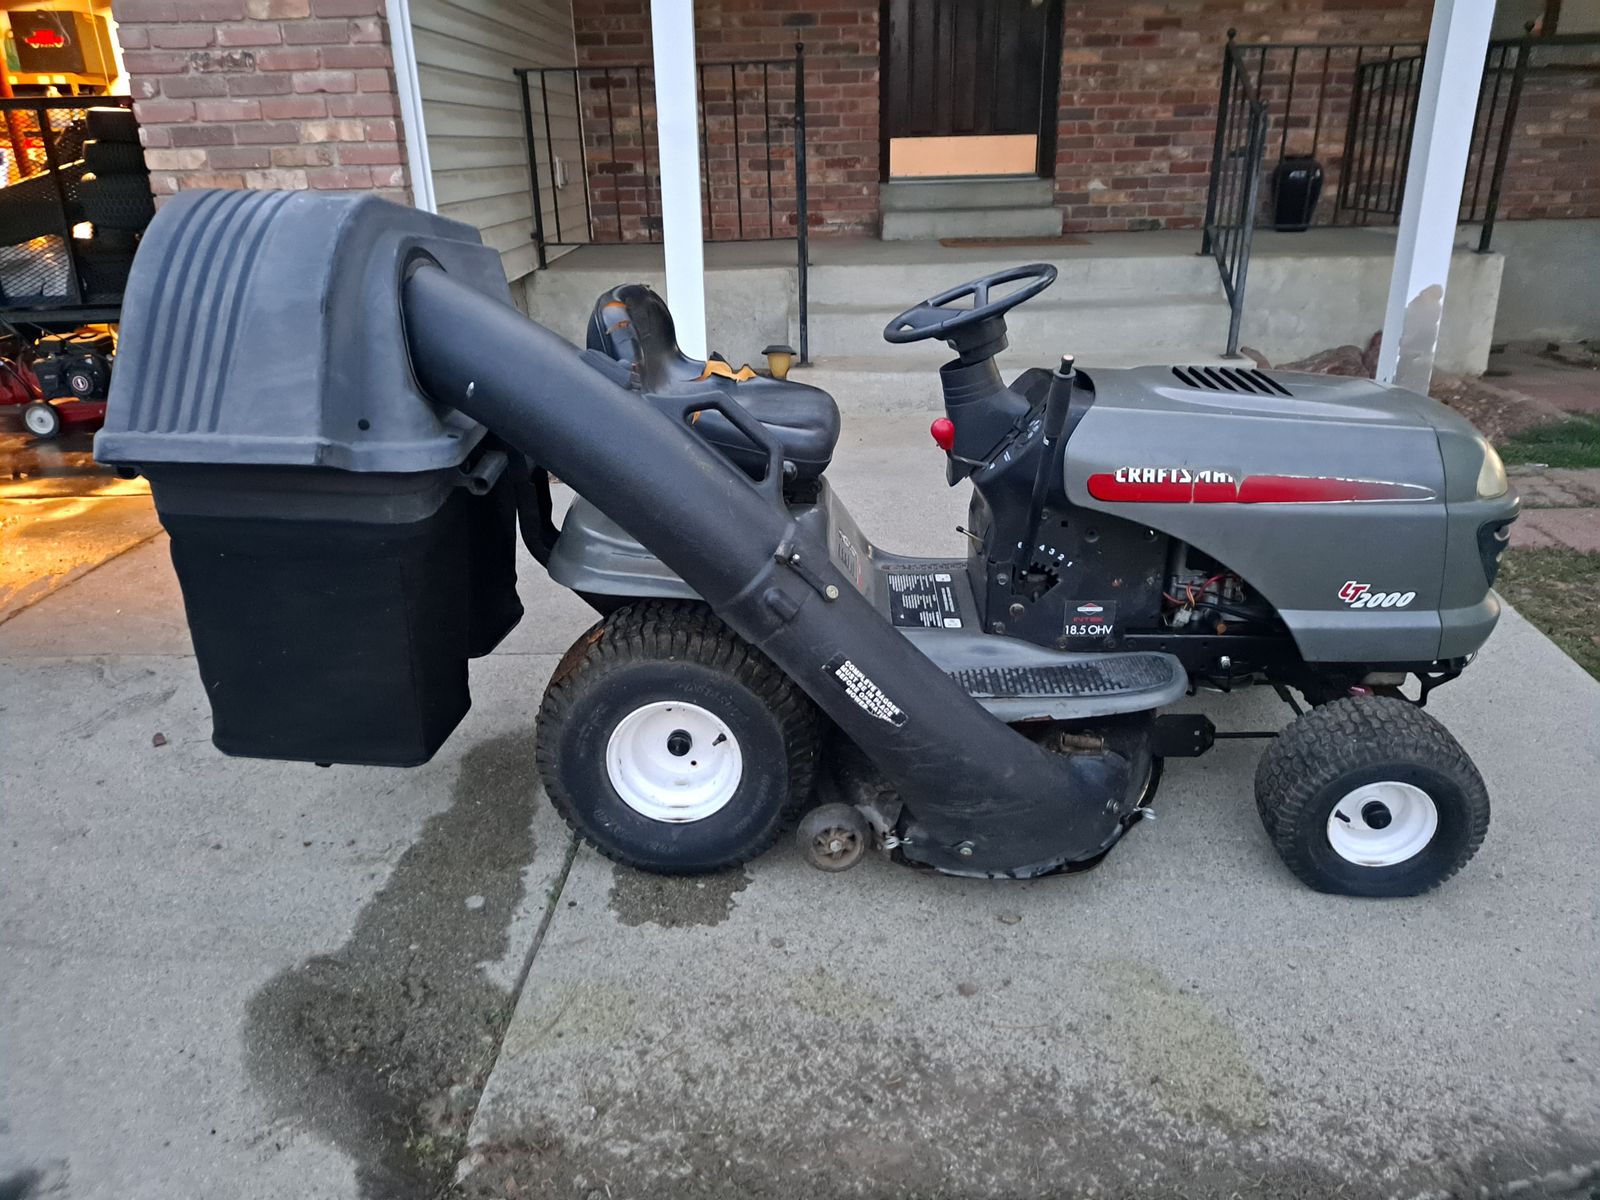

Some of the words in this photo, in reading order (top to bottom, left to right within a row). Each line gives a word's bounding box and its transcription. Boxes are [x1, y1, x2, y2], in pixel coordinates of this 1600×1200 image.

[1350, 592, 1416, 608] 2000
[1065, 625, 1086, 635] 18.5
[1088, 625, 1113, 635] OHV
[835, 669, 860, 693] BEFORE
[839, 665, 859, 682] MUST
[857, 682, 867, 692] BE
[866, 690, 874, 699] IN
[873, 697, 893, 717] PLACE
[844, 660, 878, 692] COMPLETE
[875, 689, 901, 715] BAGGER
